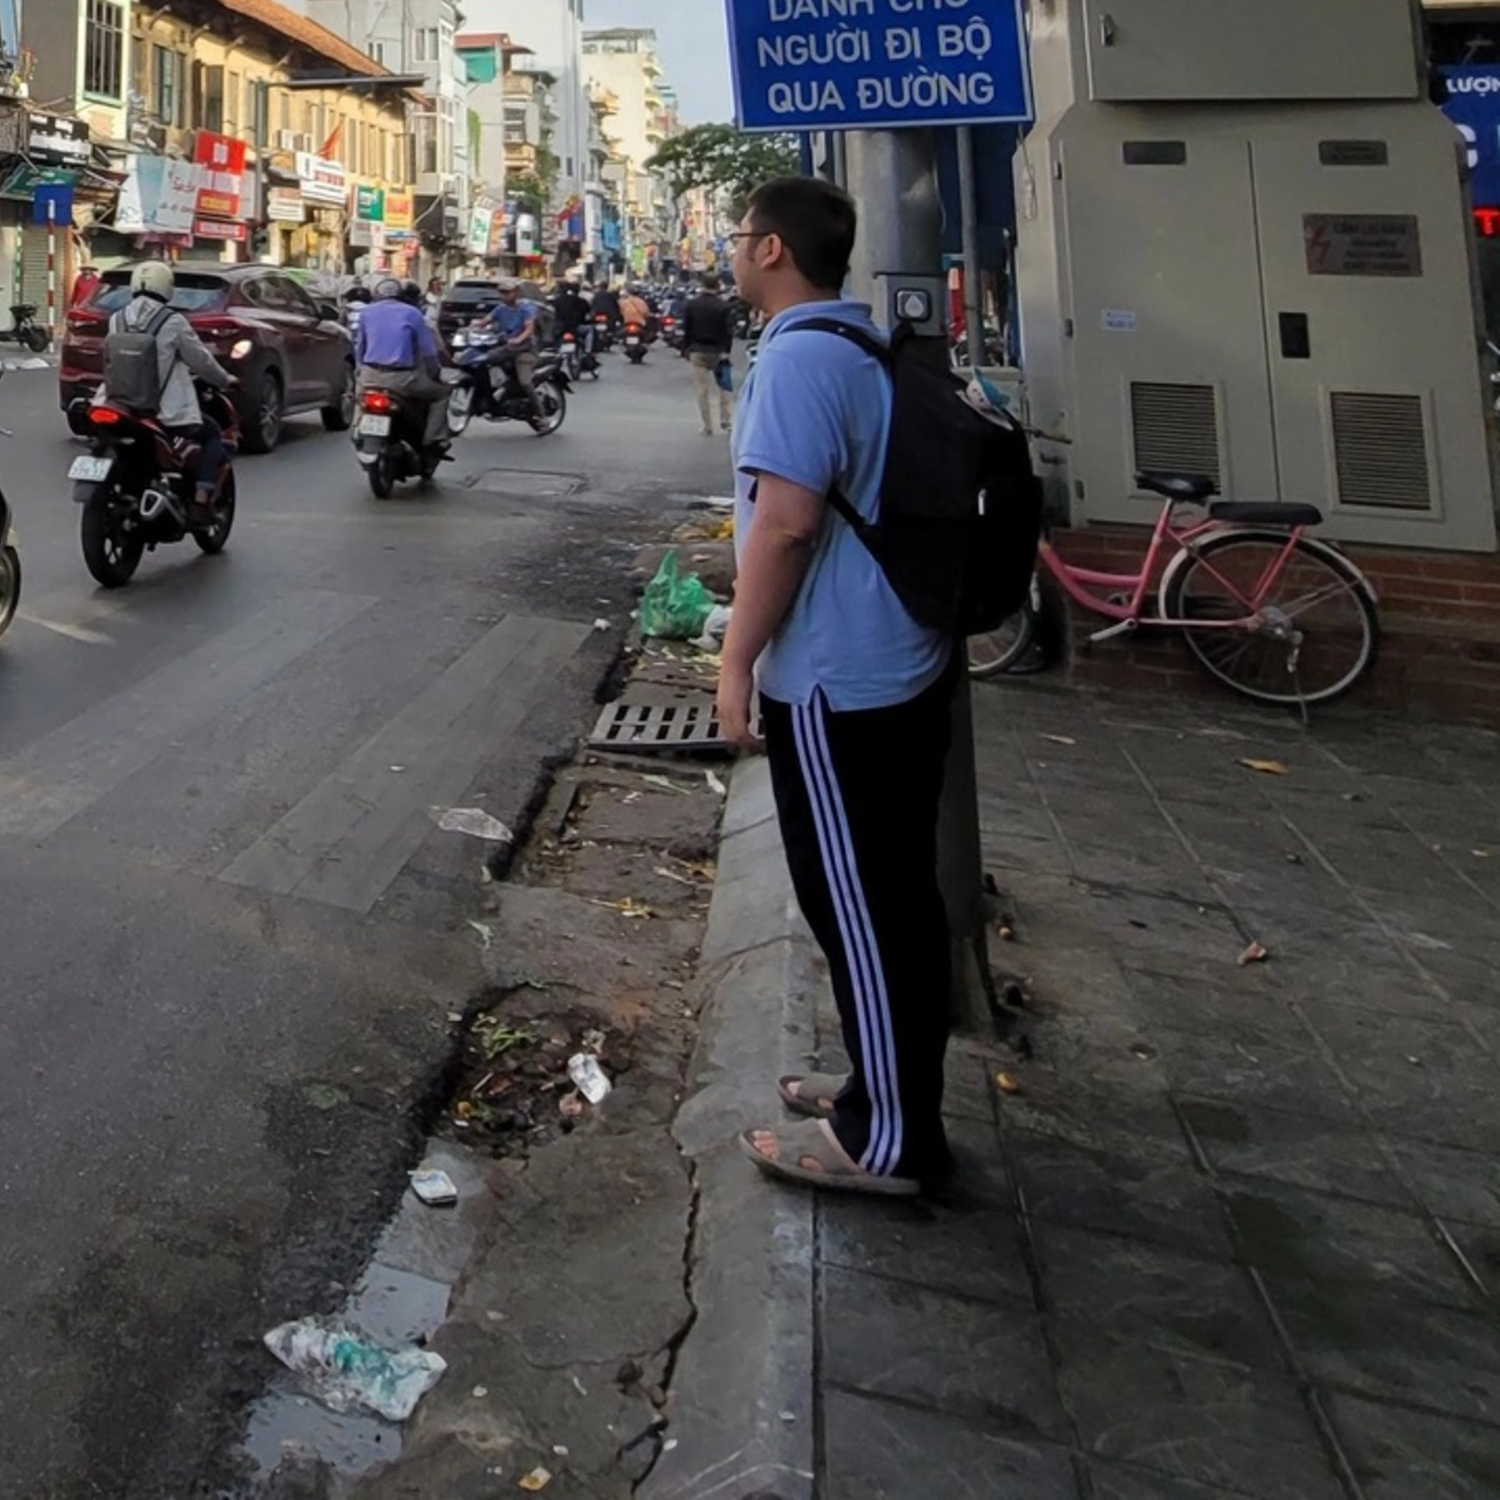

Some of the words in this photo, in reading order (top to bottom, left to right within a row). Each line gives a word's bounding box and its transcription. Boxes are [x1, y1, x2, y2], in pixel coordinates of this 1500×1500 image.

[756, 21, 871, 68] NGƯỜI
[884, 25, 922, 61] ĐI
[937, 14, 993, 62] BỘ
[767, 78, 846, 114] QUA
[856, 64, 995, 110] ĐƯỜNG
